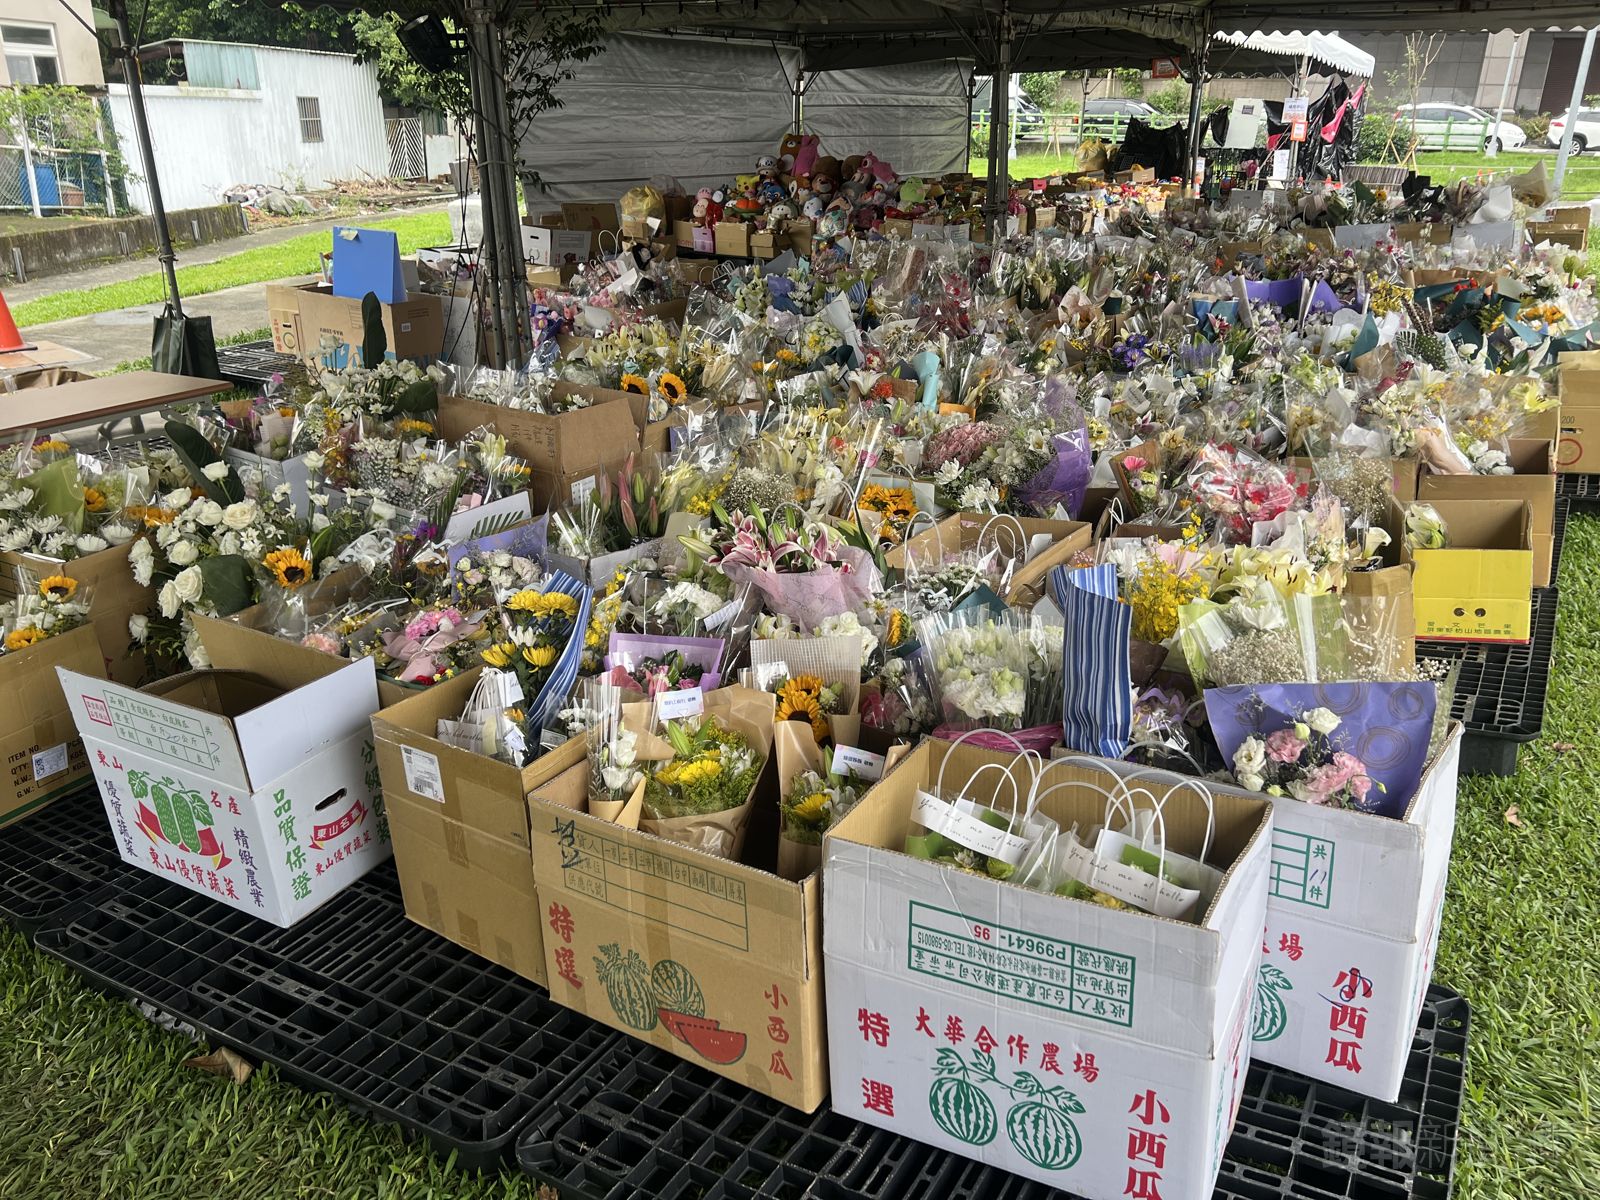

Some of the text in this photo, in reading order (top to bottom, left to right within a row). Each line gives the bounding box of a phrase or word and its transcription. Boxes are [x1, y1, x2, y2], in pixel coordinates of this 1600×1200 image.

[8, 750, 26, 763] ITEM
[11, 762, 30, 775] Q'TY:
[97, 750, 124, 771] 東山
[14, 774, 32, 787] N.W.:
[16, 786, 35, 799] G.W.:
[103, 779, 138, 859] 優質蔬菜
[210, 790, 242, 816] 名產
[272, 788, 313, 901] 品質保證
[314, 830, 373, 877] 東山優質蔬菜
[149, 847, 240, 901] 東山優質蔬菜
[232, 827, 265, 909] 精緻農業
[673, 866, 687, 882] 台中
[1159, 887, 1185, 903] hello
[548, 901, 584, 990] 特選
[973, 924, 991, 941] 95
[1076, 949, 1130, 976] 供應代號
[959, 963, 1067, 1004] 台北農產運銷公司
[1074, 972, 1129, 997] 出貨地址
[1075, 993, 1126, 1019] 收貨人
[1325, 967, 1373, 1074] 小西瓜
[763, 984, 793, 1081] 小西瓜
[914, 1006, 1100, 1083] 大華合作農場
[857, 1007, 896, 1118] 特選
[1123, 1088, 1171, 1200] 小西瓜
